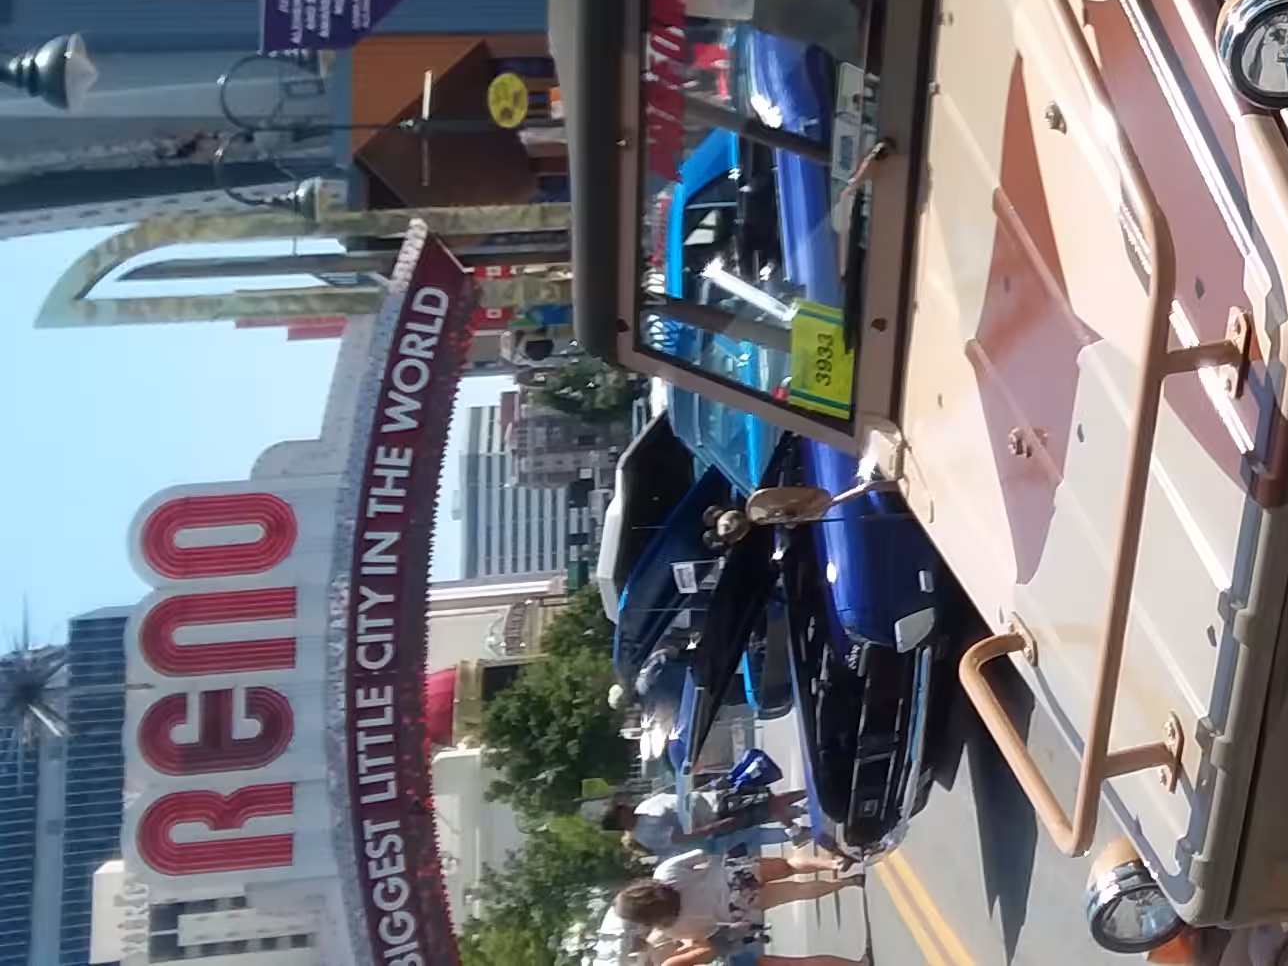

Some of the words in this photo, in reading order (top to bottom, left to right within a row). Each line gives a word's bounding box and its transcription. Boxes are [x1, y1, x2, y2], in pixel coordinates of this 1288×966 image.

[380, 285, 450, 434] WORLD
[815, 333, 833, 387] 3933
[365, 445, 414, 519] THE
[361, 530, 403, 575] IN
[356, 585, 397, 671] CITY
[135, 492, 298, 876] RENO
[355, 684, 399, 804] LITTLE
[362, 818, 426, 966] BIGGEST
